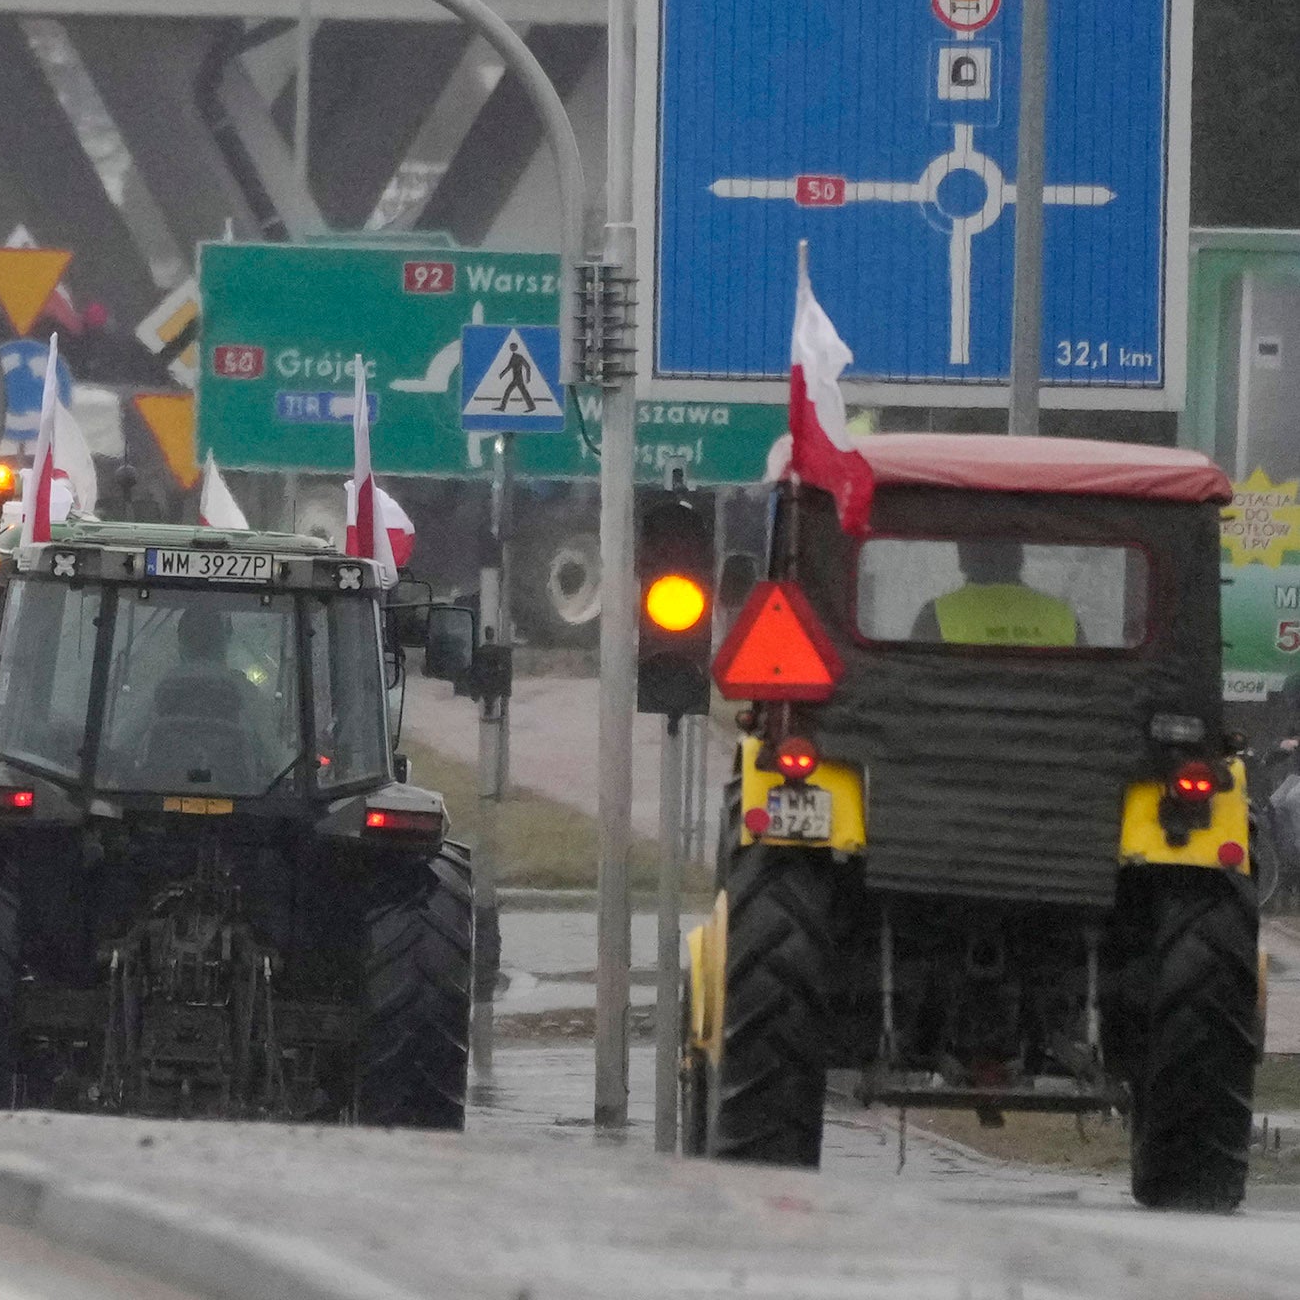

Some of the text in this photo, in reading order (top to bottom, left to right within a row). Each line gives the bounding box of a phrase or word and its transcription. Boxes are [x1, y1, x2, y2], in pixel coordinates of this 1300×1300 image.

[414, 264, 561, 293] 92 Warsz
[1057, 340, 1153, 370] 32,1 km
[577, 395, 730, 425] Wszawa
[1233, 493, 1290, 507] OTACJA
[1245, 508, 1269, 522] DO
[162, 552, 268, 579] WM 3927P
